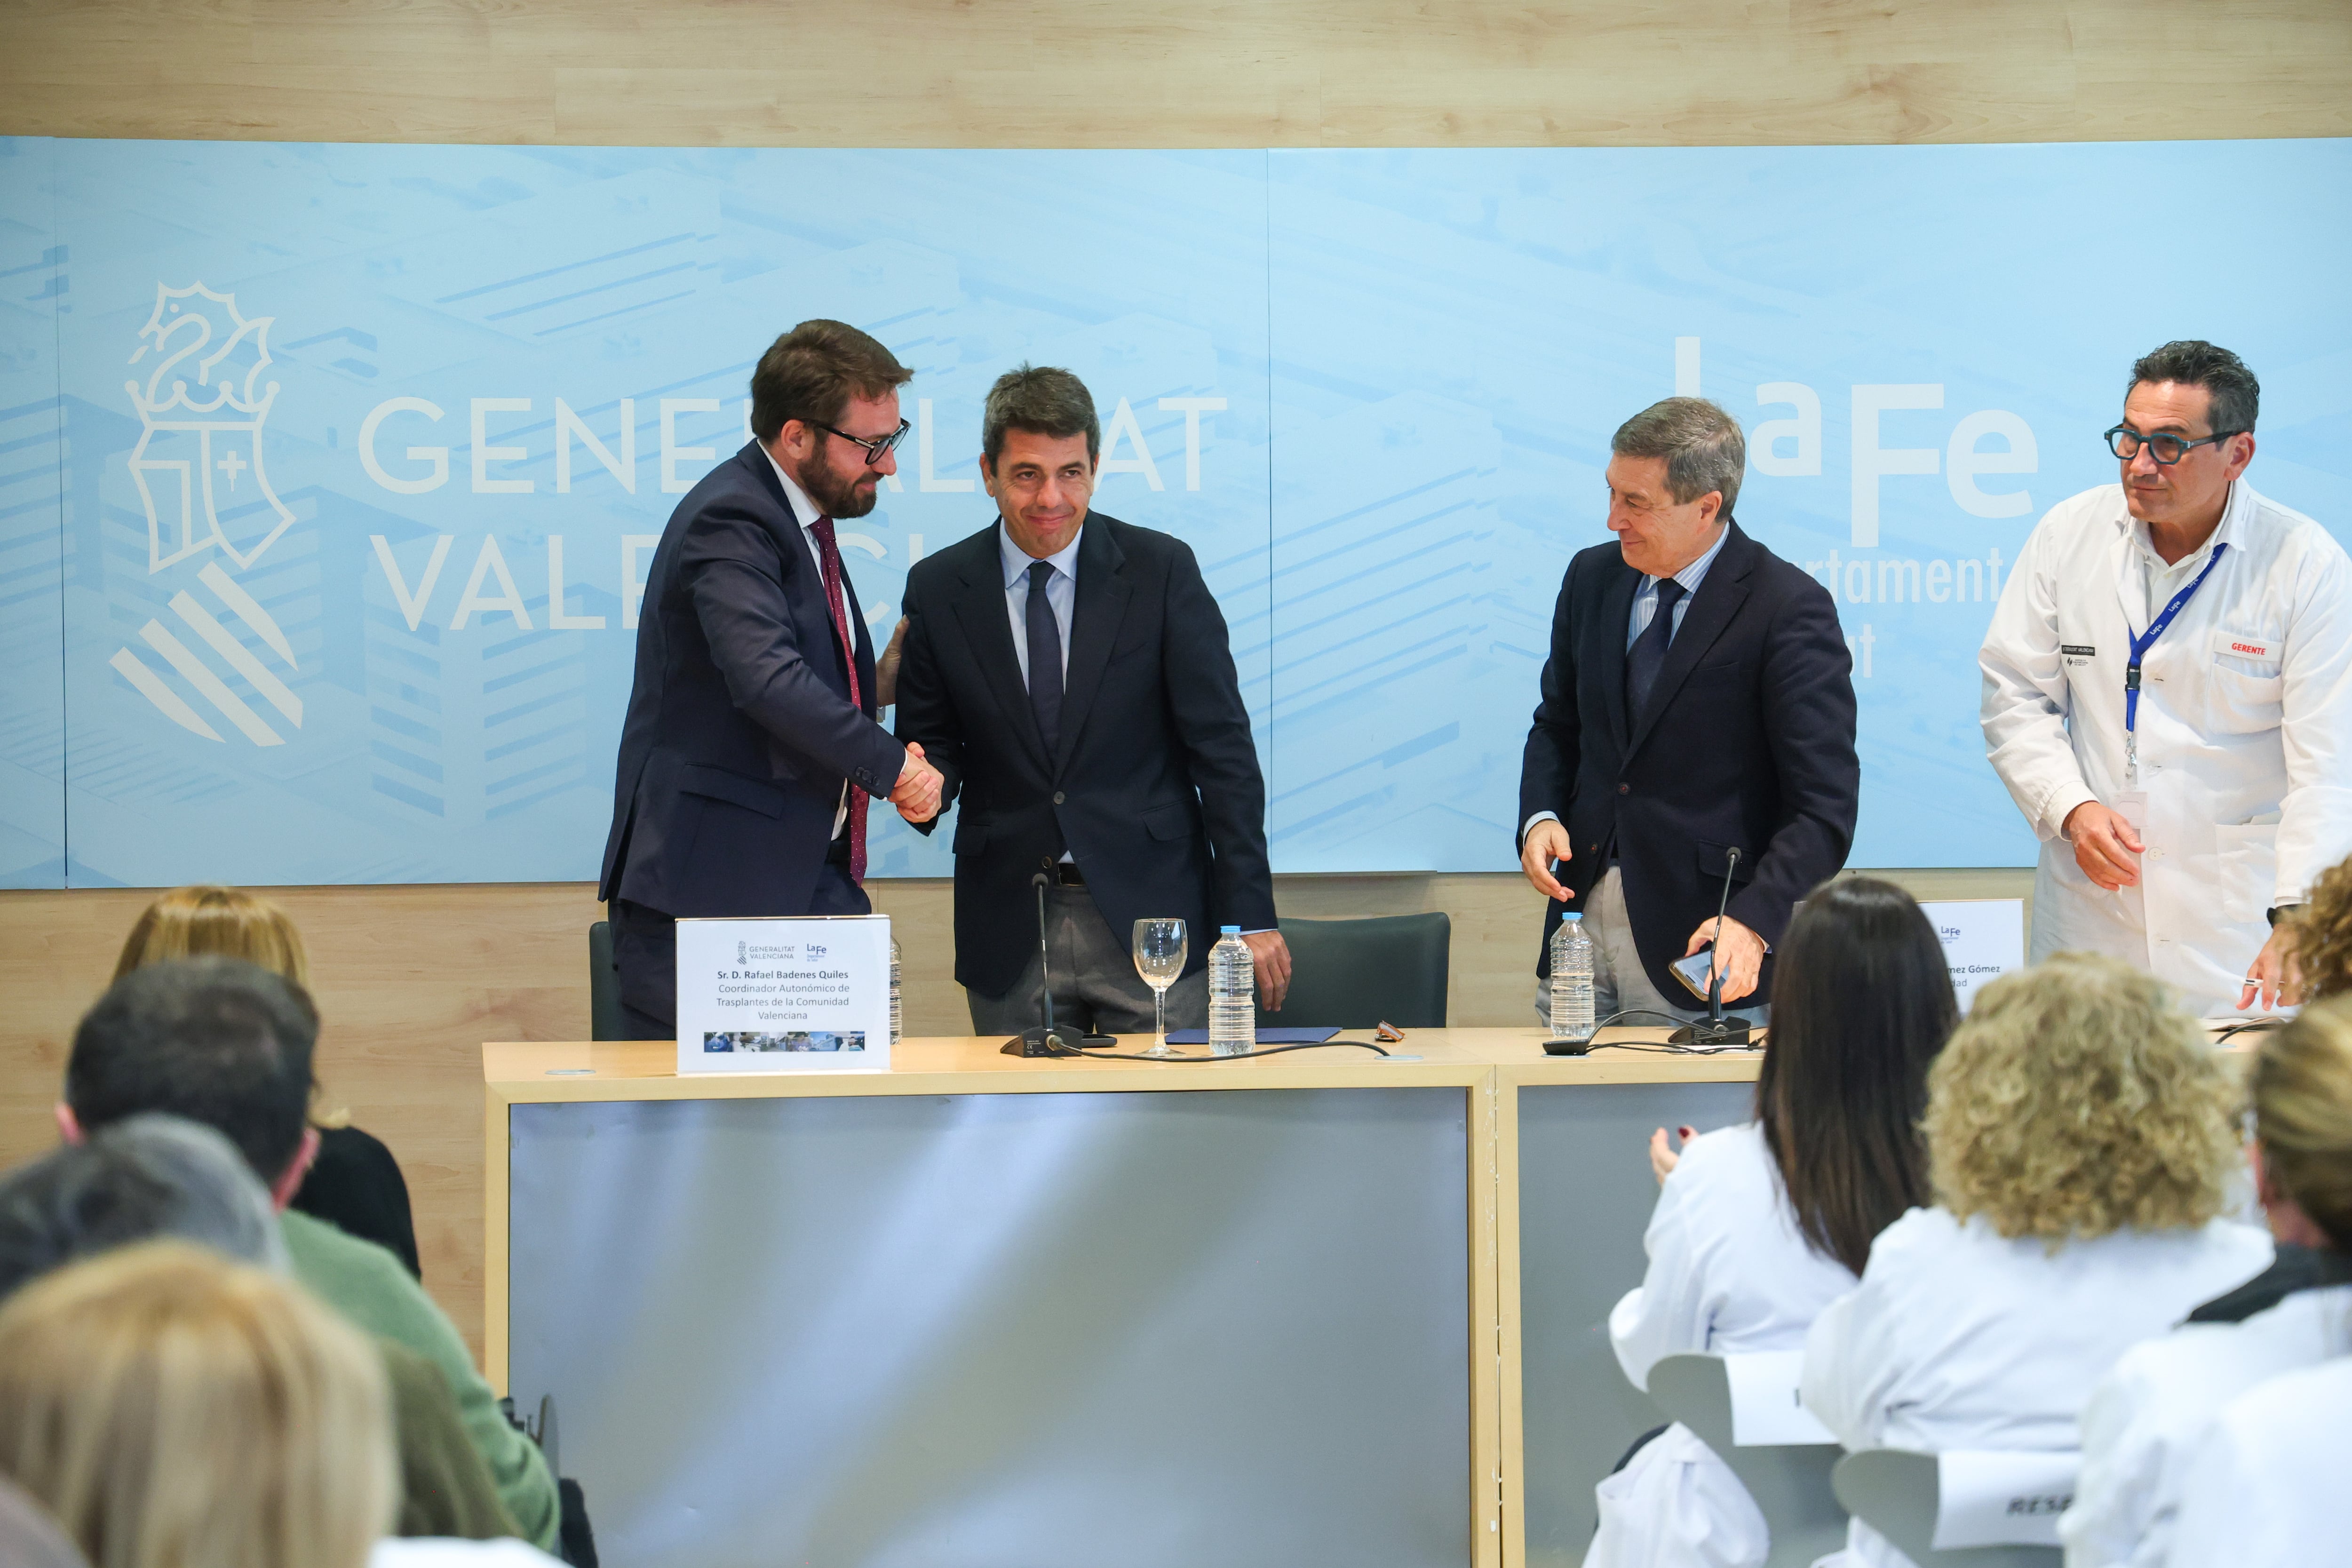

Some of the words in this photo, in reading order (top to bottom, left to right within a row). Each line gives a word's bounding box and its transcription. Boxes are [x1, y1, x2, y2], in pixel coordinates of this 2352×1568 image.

[358, 397, 1227, 494] GENELAT
[2232, 643, 2266, 655] GERENTE
[1968, 964, 2001, 973] Gómez
[819, 971, 849, 979] Quiles
[719, 984, 776, 993] Coordinador
[779, 983, 835, 992] Autonómico
[717, 998, 769, 1008] Trasplantes
[796, 997, 849, 1006] Comunidad
[758, 1011, 807, 1019] Valenciana
[2006, 1493, 2074, 1516] RESE
